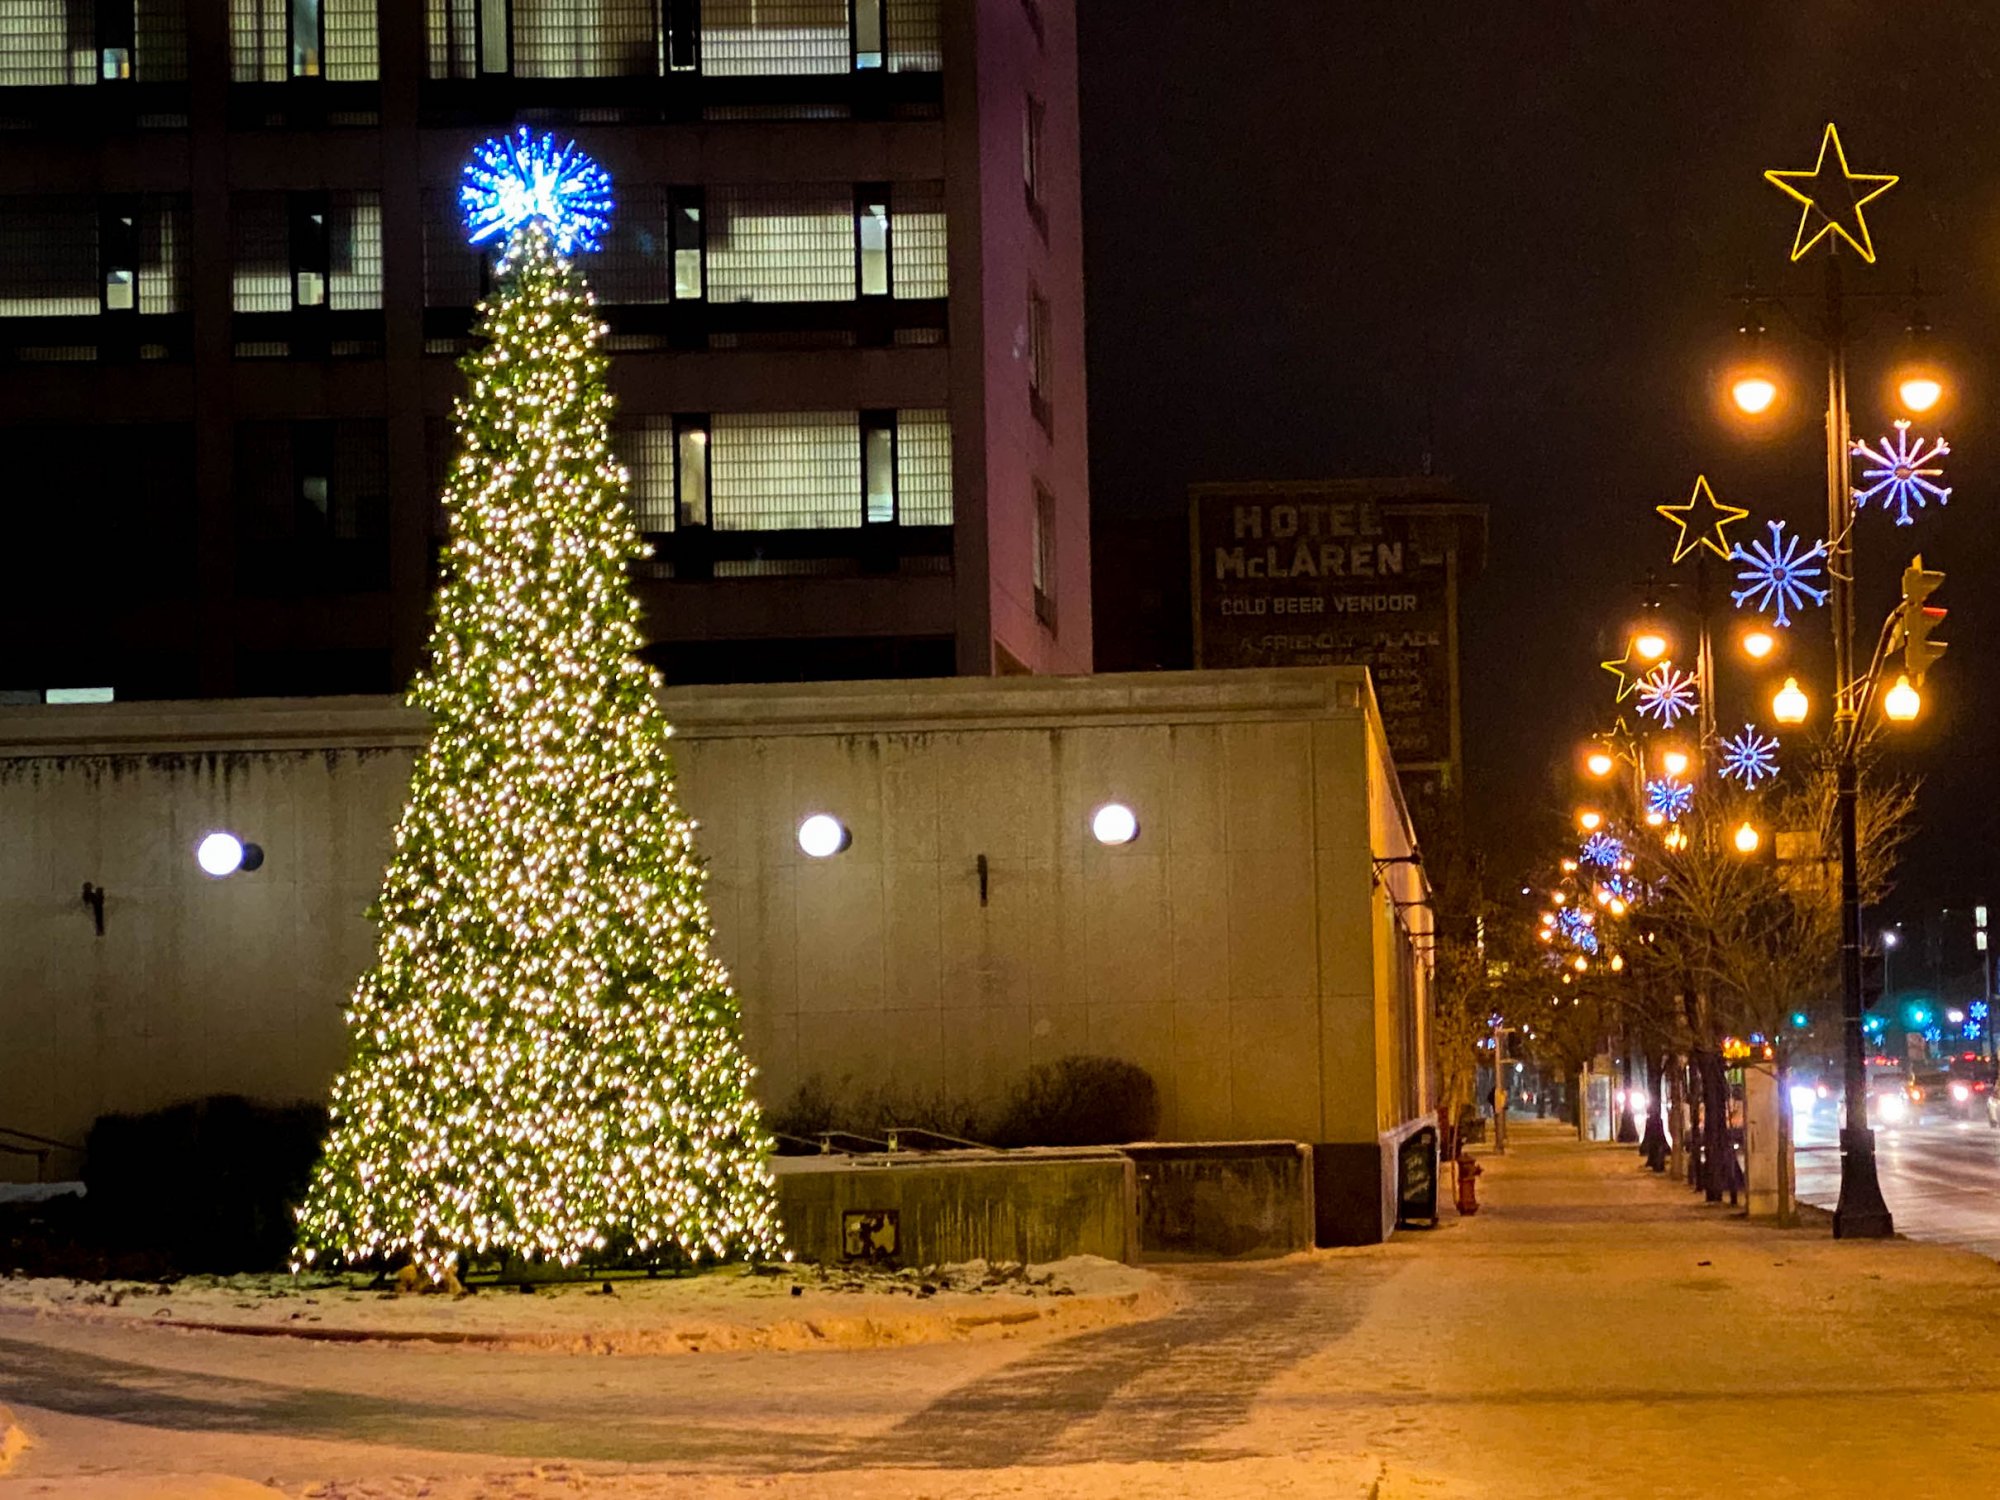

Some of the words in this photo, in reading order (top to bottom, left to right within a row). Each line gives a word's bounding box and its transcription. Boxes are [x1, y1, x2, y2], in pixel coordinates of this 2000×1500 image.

[1233, 504, 1383, 539] HOTEL
[1216, 542, 1403, 579] McLAREN
[1221, 597, 1266, 615] COLD
[1273, 596, 1325, 614] BEER
[1334, 595, 1417, 612] VENDOR
